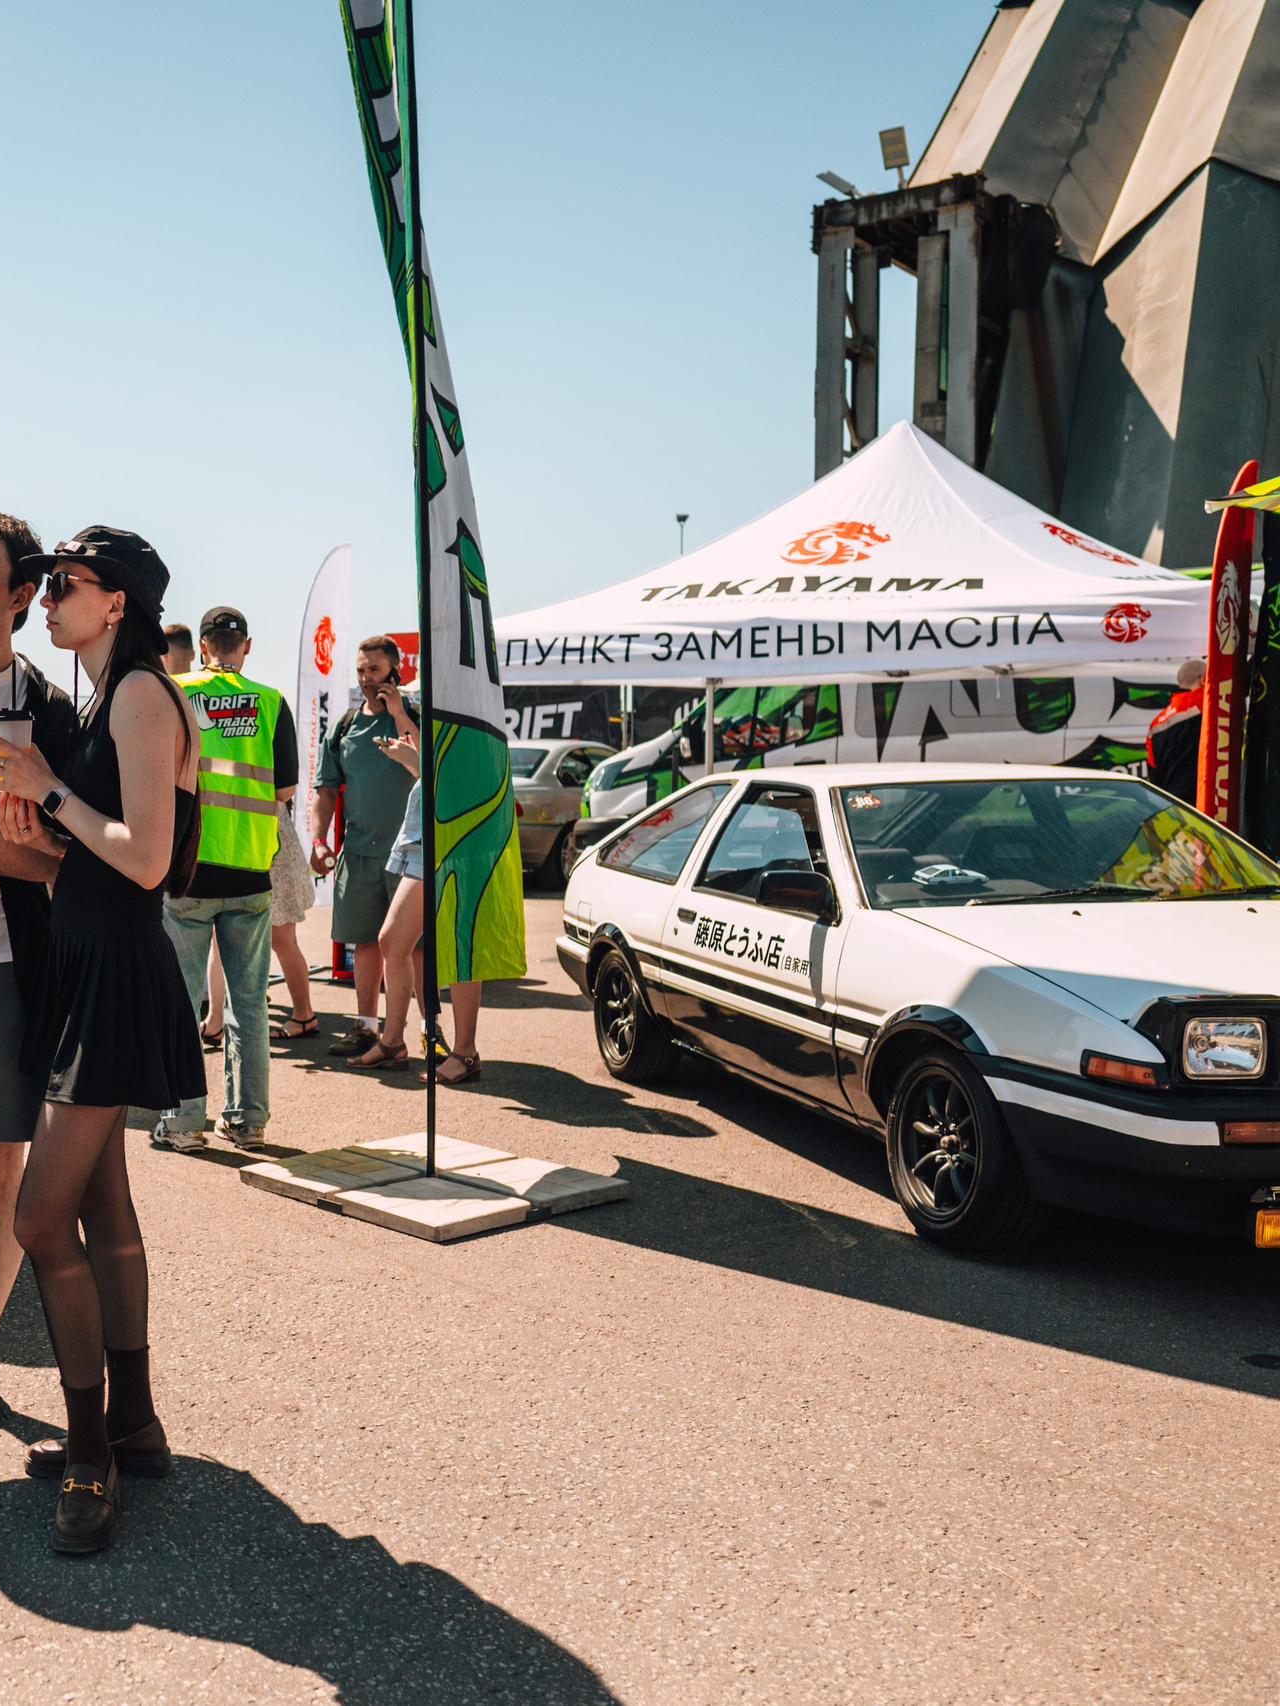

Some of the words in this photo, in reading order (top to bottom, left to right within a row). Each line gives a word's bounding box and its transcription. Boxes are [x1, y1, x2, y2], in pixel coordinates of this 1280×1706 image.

[640, 575, 984, 602] TAKAYAMA
[505, 633, 640, 667] ПУНКТ
[651, 621, 845, 663] ЗАМЕНЫ
[866, 612, 1065, 653] МАСЛА
[208, 693, 259, 711] DRIFT
[232, 708, 253, 716] EXPO
[504, 701, 583, 740] RIFT
[310, 697, 318, 748] МАСЛА
[306, 751, 315, 833] МОТОРНЫЕ
